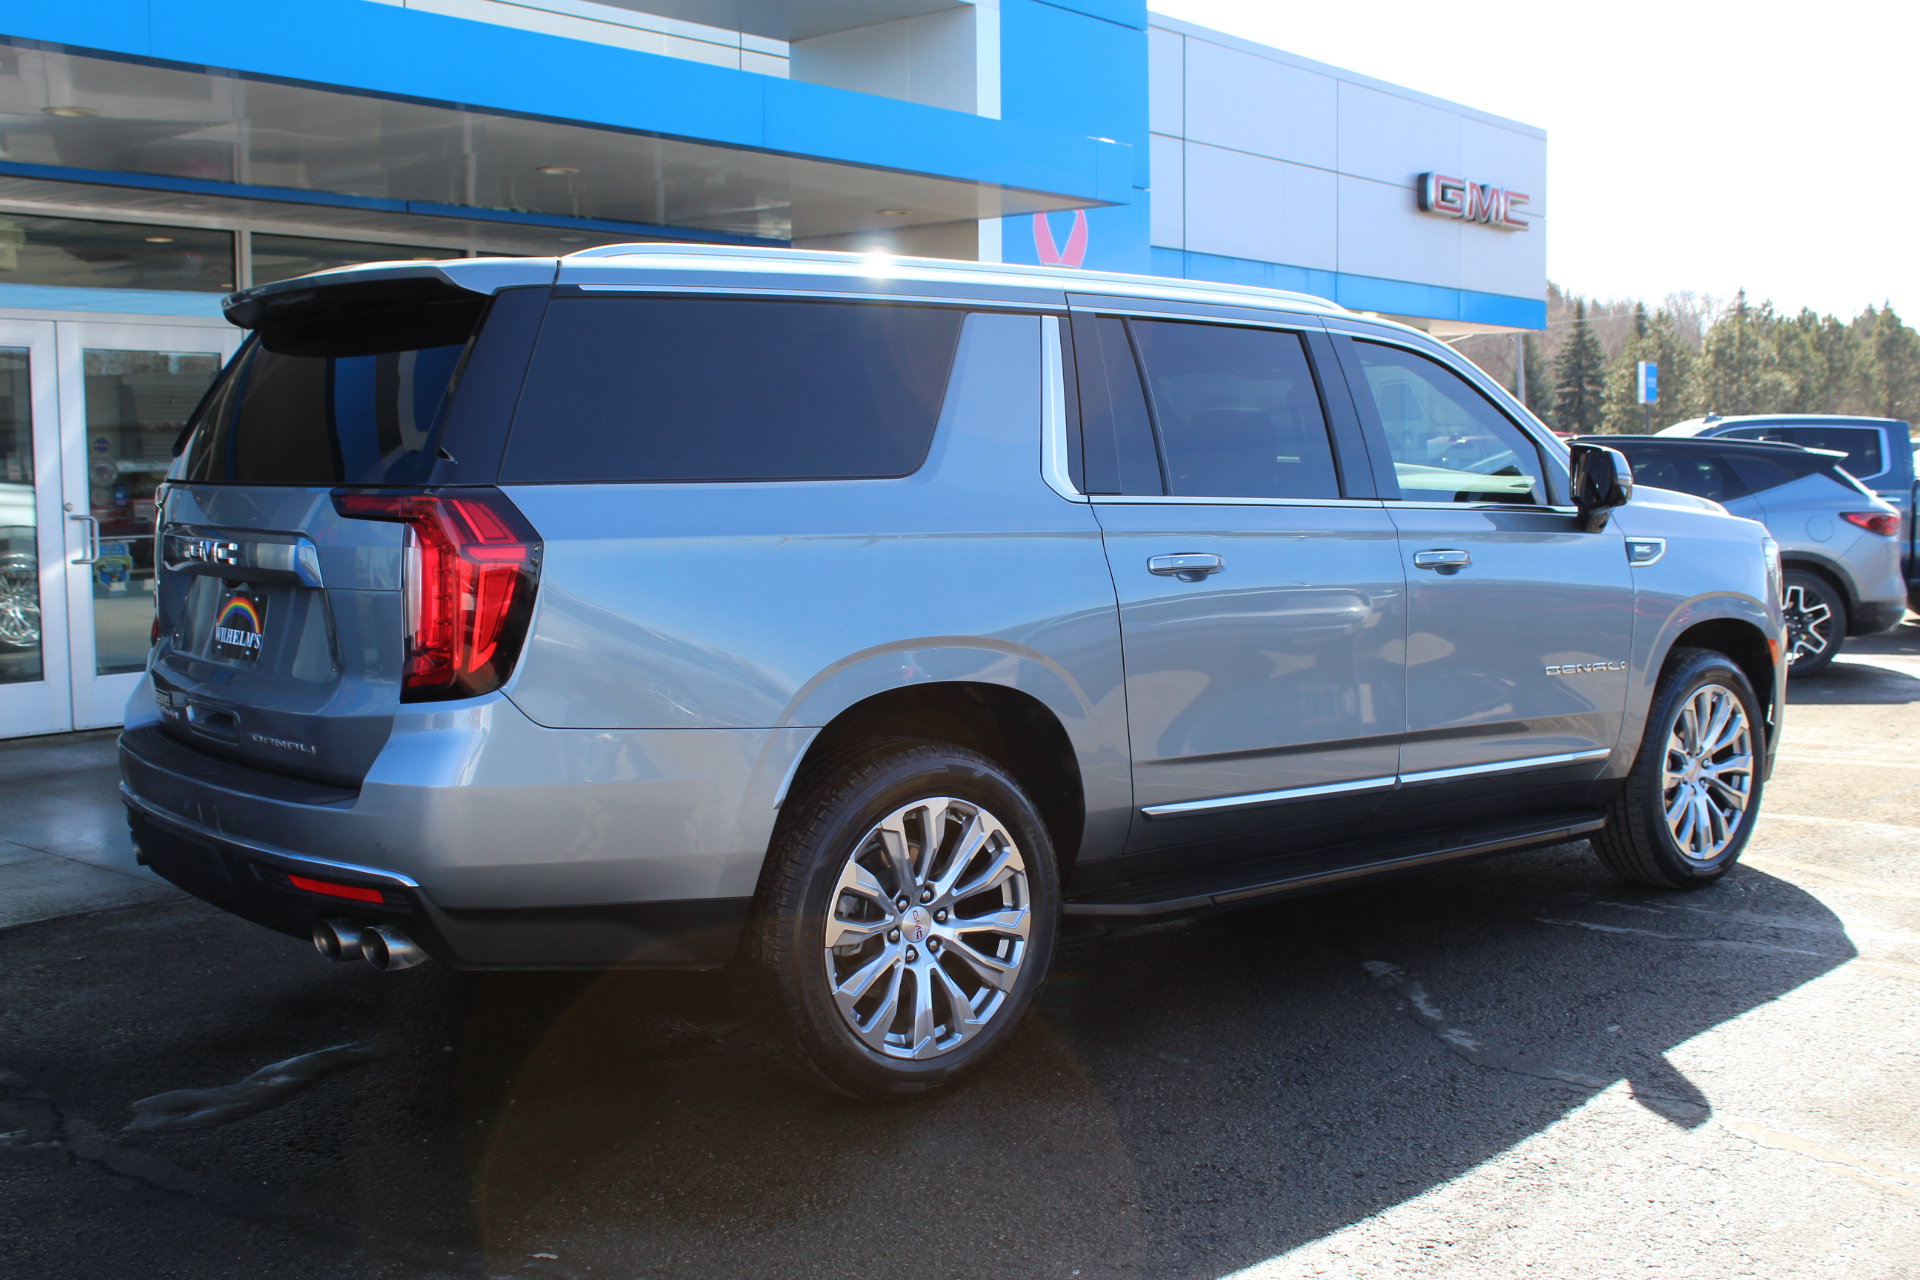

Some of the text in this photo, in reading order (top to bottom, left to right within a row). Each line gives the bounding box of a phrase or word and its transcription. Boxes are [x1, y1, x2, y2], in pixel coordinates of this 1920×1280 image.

[1418, 171, 1529, 230] GMC
[182, 541, 238, 566] GMC
[1634, 545, 1651, 553] GMC
[215, 626, 262, 648] WILHELM'S
[1545, 661, 1626, 676] DENALI
[251, 734, 316, 755] DENALI
[913, 911, 923, 939] GMC
